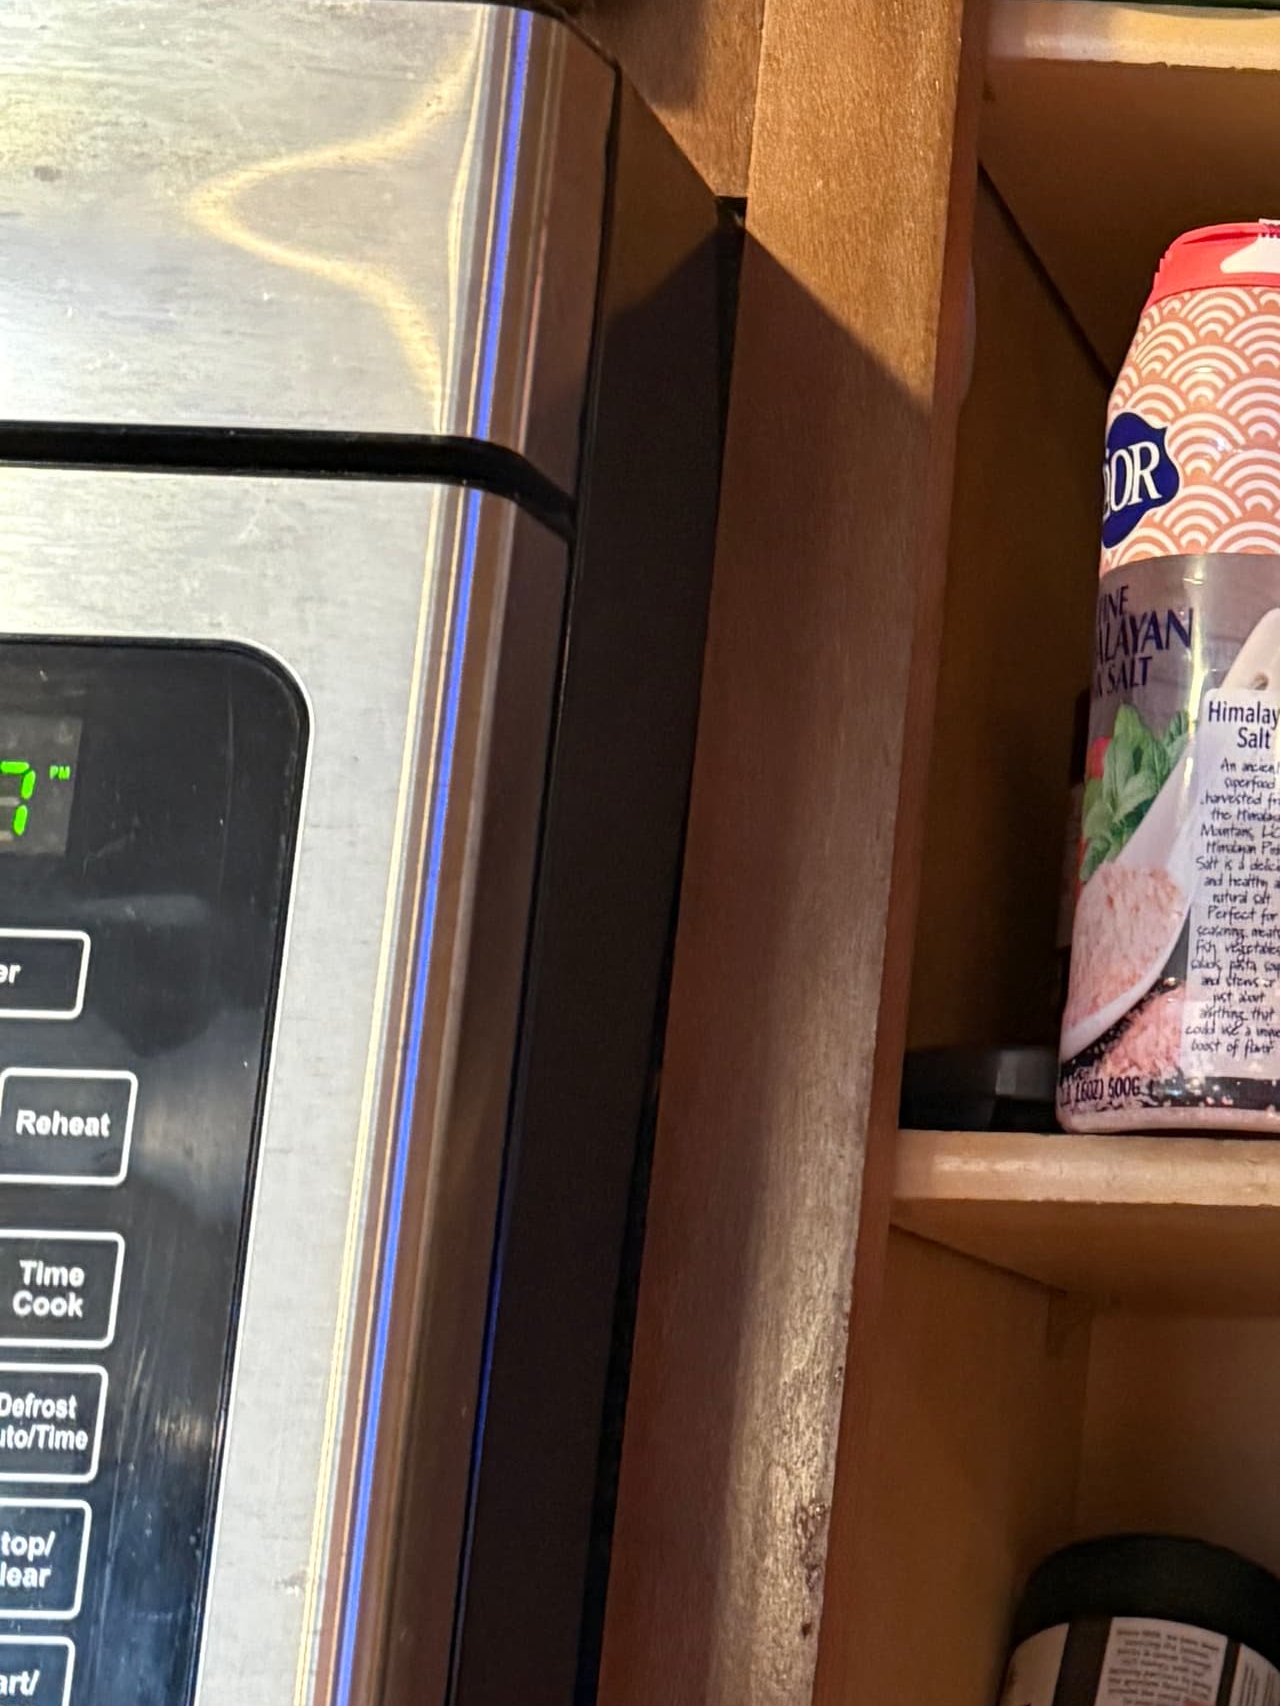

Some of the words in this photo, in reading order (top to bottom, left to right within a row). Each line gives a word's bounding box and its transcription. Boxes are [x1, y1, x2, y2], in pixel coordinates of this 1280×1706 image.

[1237, 727, 1271, 750] Salt
[49, 765, 70, 780] PM
[1207, 905, 1256, 925] Perfect
[16, 1110, 111, 1137] Reheat
[19, 1259, 85, 1286] Time
[13, 1291, 85, 1317] Cook
[0, 1395, 77, 1420] Defrost
